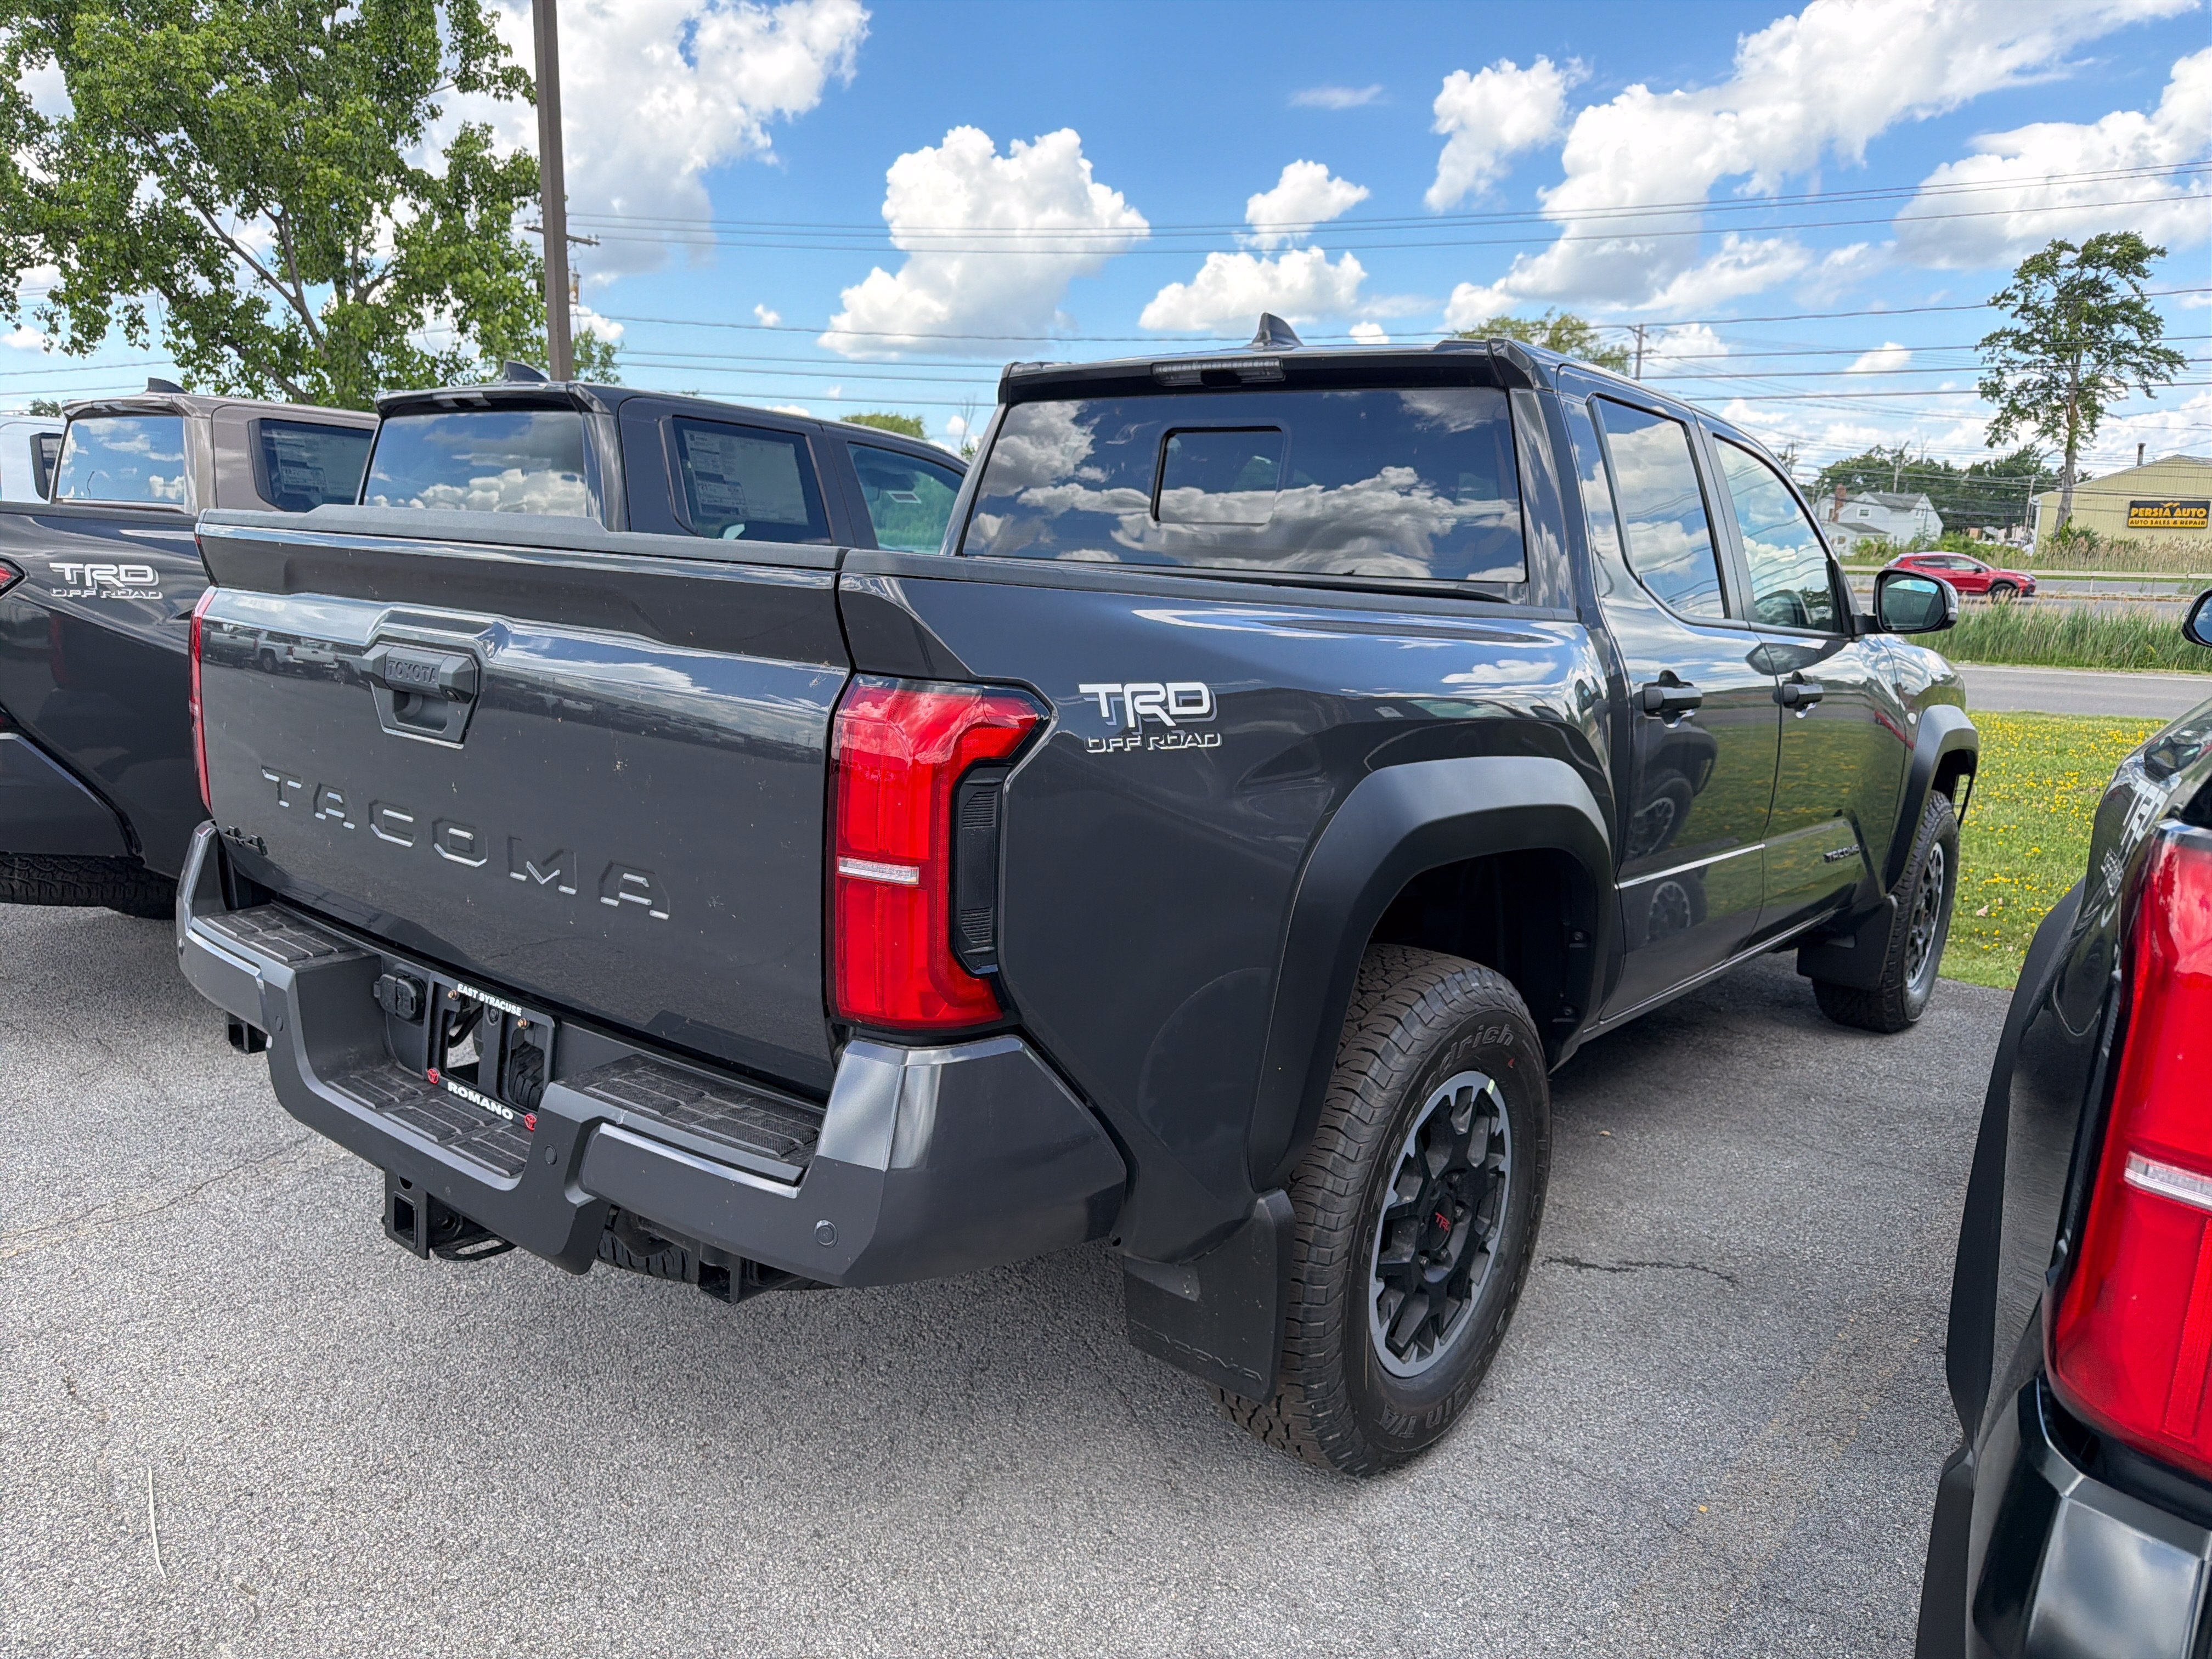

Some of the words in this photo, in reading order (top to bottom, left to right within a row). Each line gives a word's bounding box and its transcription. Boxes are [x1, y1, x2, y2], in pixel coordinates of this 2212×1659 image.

[2130, 507, 2171, 517] PERSIA
[2173, 507, 2207, 517] AUTO
[49, 562, 159, 589] TRD
[50, 588, 97, 599] OFF
[100, 588, 163, 600] ROAD
[387, 660, 439, 685] TOYOTA
[1079, 682, 1217, 734] TRD
[1084, 735, 1142, 753] OFF
[1146, 732, 1223, 751] ROAD
[261, 765, 670, 920] TACOMA
[457, 983, 478, 998] EAST
[479, 992, 522, 1017] SYRACUSE
[448, 1081, 513, 1120] ROMANO
